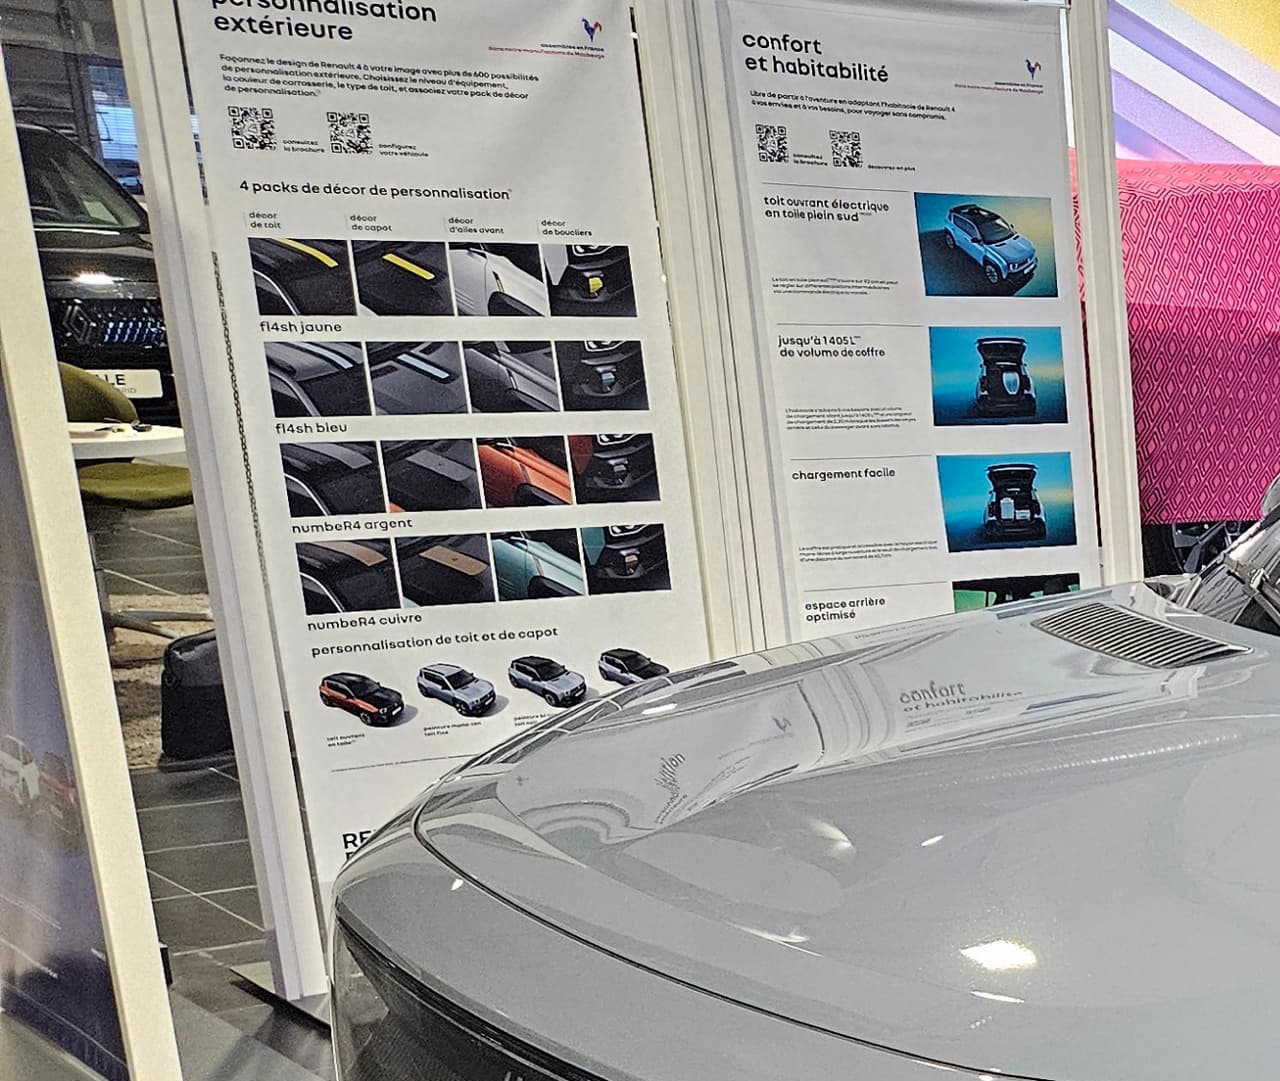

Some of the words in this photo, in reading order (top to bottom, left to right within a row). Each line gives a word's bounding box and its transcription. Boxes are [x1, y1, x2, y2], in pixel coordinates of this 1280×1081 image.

[214, 15, 352, 40] extérieure
[742, 34, 822, 55] confort
[744, 56, 768, 72] et
[772, 55, 888, 82] habitabilité
[239, 180, 248, 191] 4
[252, 181, 298, 194] packs
[301, 182, 320, 193] de
[322, 183, 366, 195] décor
[369, 184, 387, 195] de
[390, 187, 510, 199] personnalisation
[763, 195, 785, 205] toit
[786, 198, 829, 208] ouvrant
[831, 198, 889, 212] électrique
[249, 212, 276, 220] décor
[350, 214, 376, 222] décor
[764, 209, 780, 218] en
[782, 208, 805, 219] toile
[806, 210, 834, 221] plein
[836, 211, 860, 221] sud
[264, 221, 281, 229] toit
[554, 228, 592, 236] boucliers
[259, 320, 298, 332] fl4sh
[300, 320, 342, 334] jaune
[778, 335, 821, 348] jusqu'à
[779, 347, 794, 357] de
[796, 347, 839, 357] volume
[840, 347, 853, 357] de
[854, 347, 885, 357] coffre
[275, 422, 313, 434] fl4sh
[315, 422, 347, 432] bleu
[792, 470, 862, 481] chargement
[864, 467, 895, 477] facile
[291, 520, 361, 533] numbeR4
[364, 519, 412, 531] argent
[804, 601, 846, 613] espace
[848, 596, 885, 608] arrière
[307, 616, 376, 631] numbeR4
[378, 613, 422, 625] cuivre
[806, 609, 856, 623] optimisé
[311, 637, 432, 658] personnalisation
[435, 634, 451, 645] de
[454, 631, 479, 643] toit
[481, 632, 496, 641] et
[498, 629, 515, 640] de
[518, 627, 558, 640] capot
